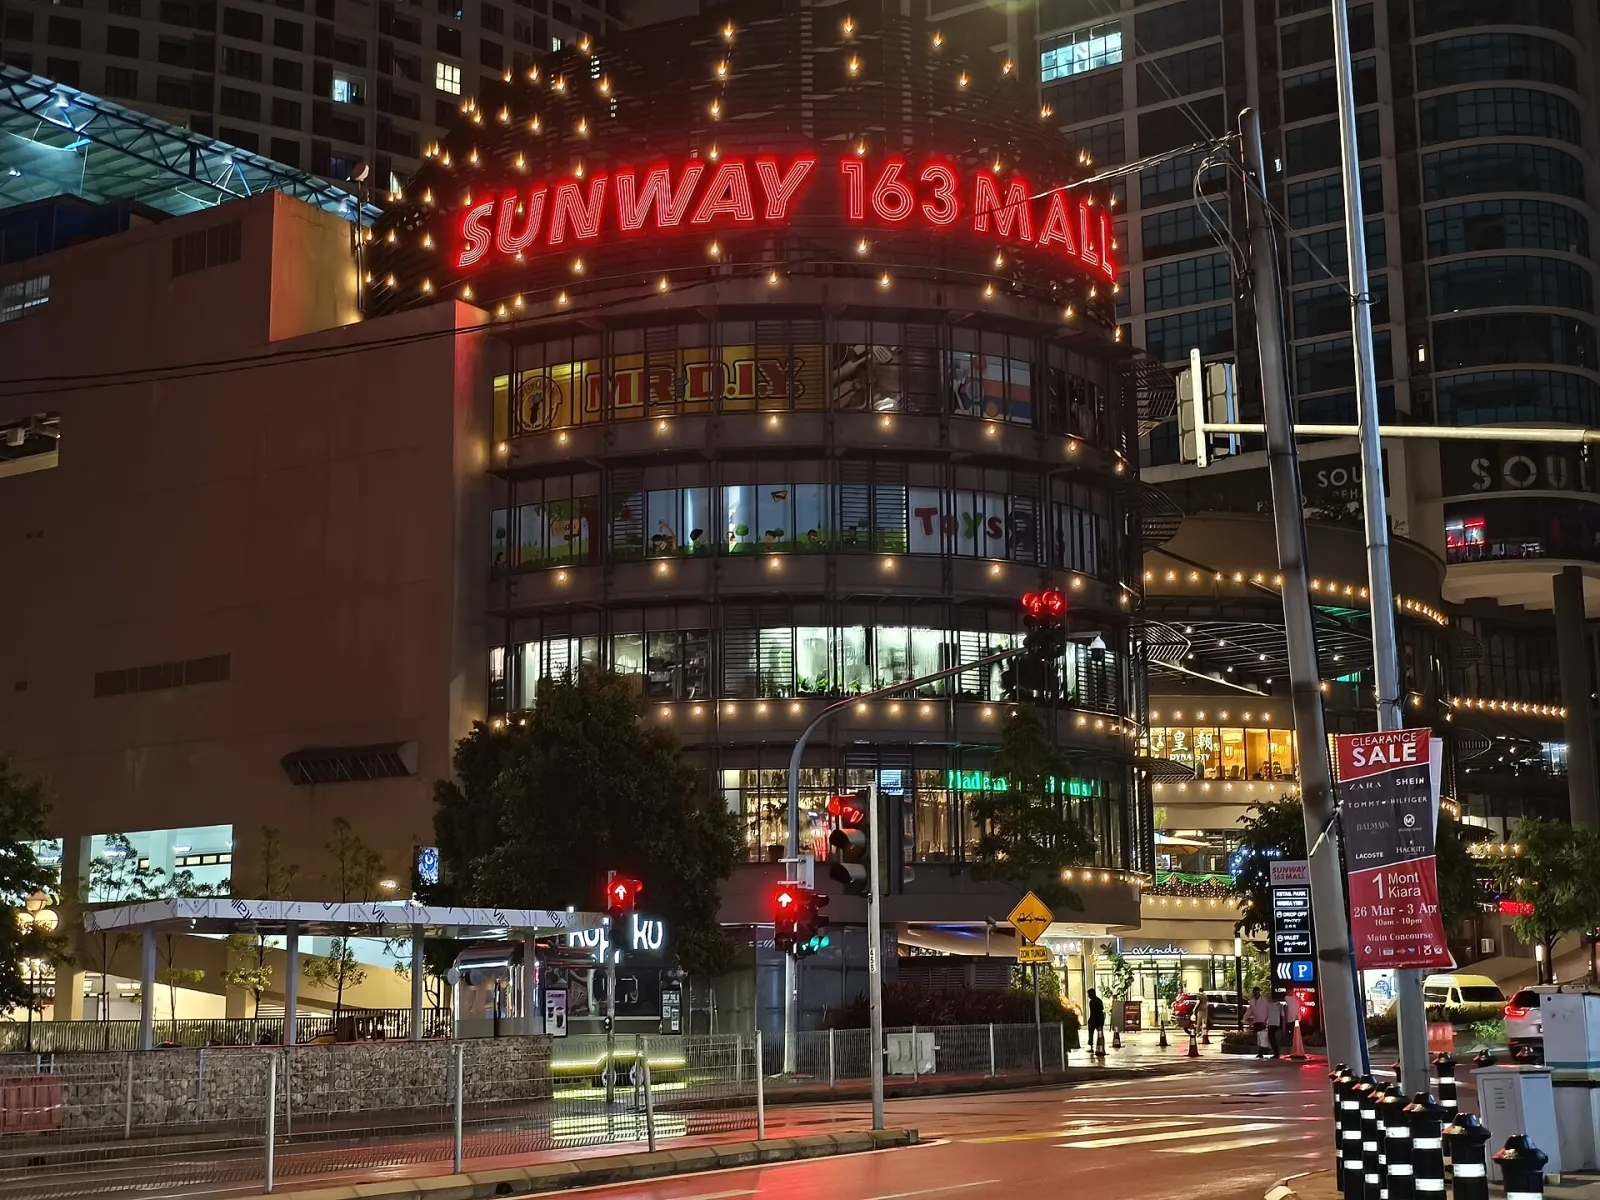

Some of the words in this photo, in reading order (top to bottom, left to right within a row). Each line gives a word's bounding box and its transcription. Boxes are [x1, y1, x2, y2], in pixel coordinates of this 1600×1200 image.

[457, 159, 817, 268] SUNWAY
[842, 161, 958, 225] 163
[974, 175, 1113, 278] MALL
[1351, 732, 1417, 747] CLEARANCE
[1352, 743, 1417, 767] SALE
[1349, 782, 1382, 790] ZARA
[1396, 777, 1425, 786] SHEIN
[1348, 800, 1380, 808] TOMMY
[1390, 796, 1427, 804] HILFIGER
[1372, 872, 1384, 899] 1
[1388, 872, 1419, 884] Mont
[1389, 886, 1421, 898] Kiara
[1354, 907, 1367, 918] 26
[1372, 905, 1395, 917] Mar
[1407, 904, 1414, 915] 3
[1367, 933, 1387, 942] Main
[1389, 932, 1433, 941] Concourse
[1116, 936, 1188, 955] Lavender
[1298, 964, 1307, 978] P
